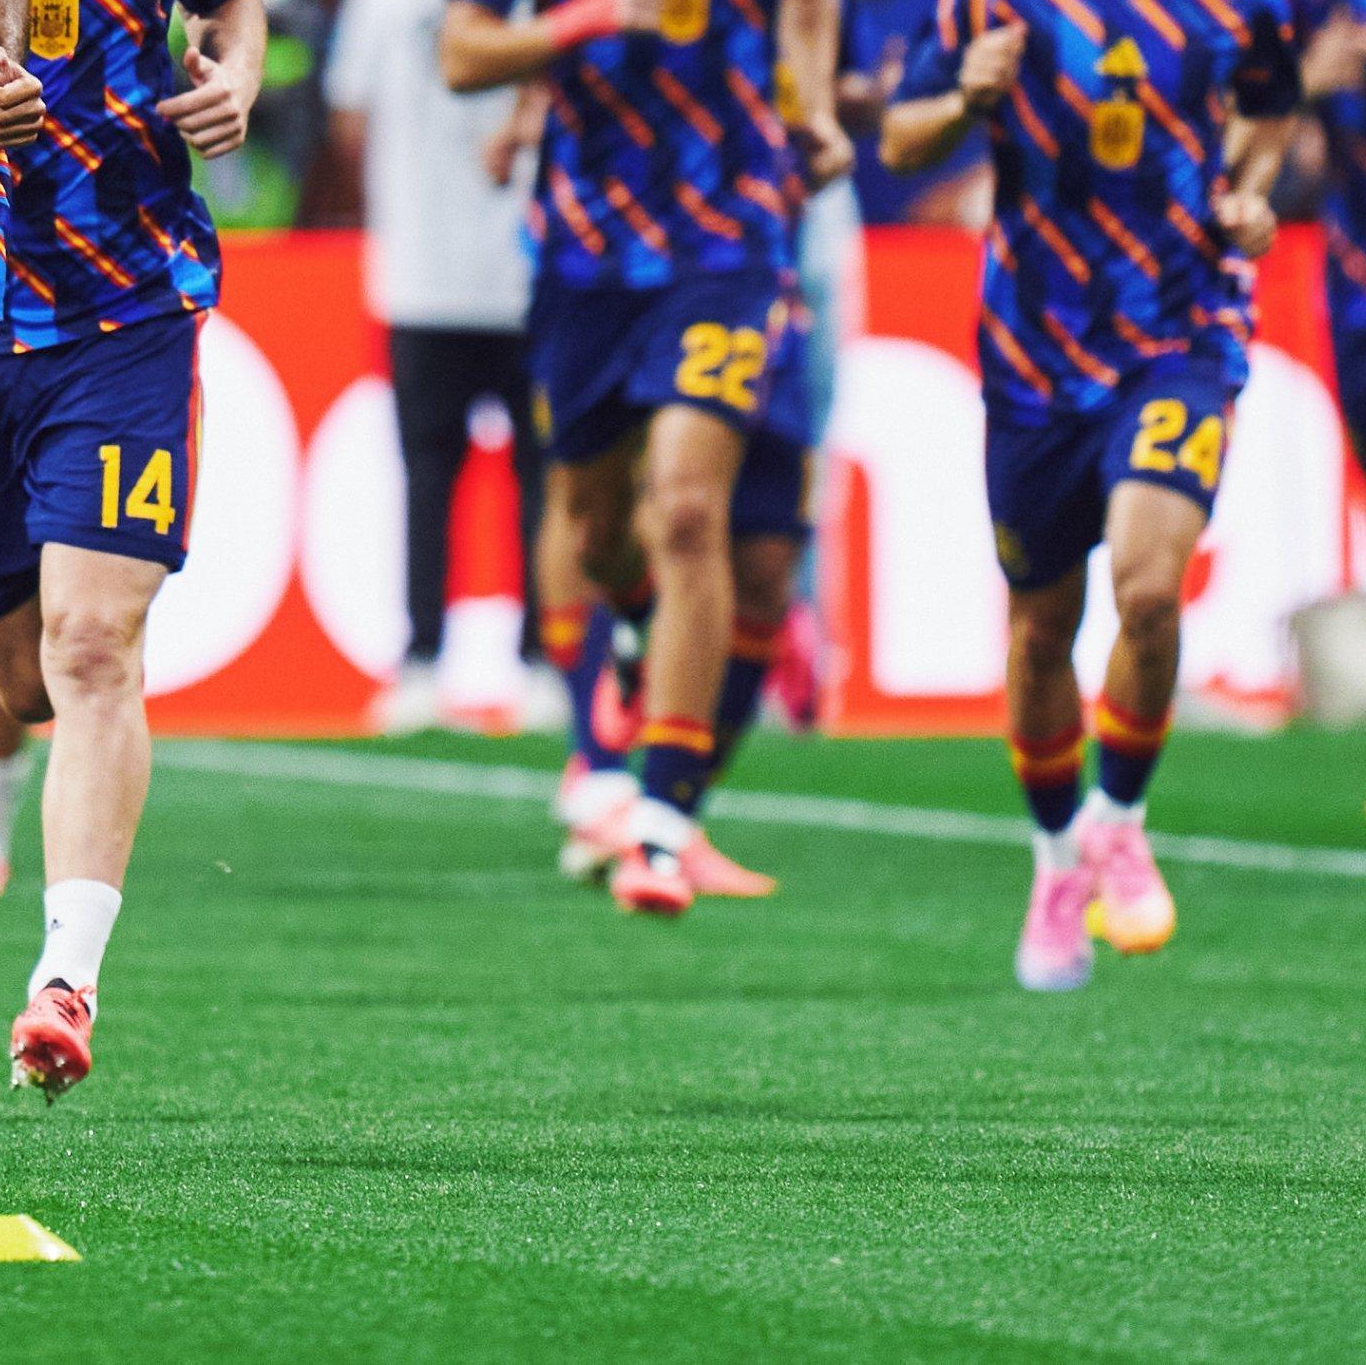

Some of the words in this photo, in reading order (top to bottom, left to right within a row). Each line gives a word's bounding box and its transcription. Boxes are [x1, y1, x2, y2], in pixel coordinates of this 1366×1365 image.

[675, 322, 766, 411] 22
[1130, 398, 1223, 490] 24
[99, 445, 176, 535] 14
